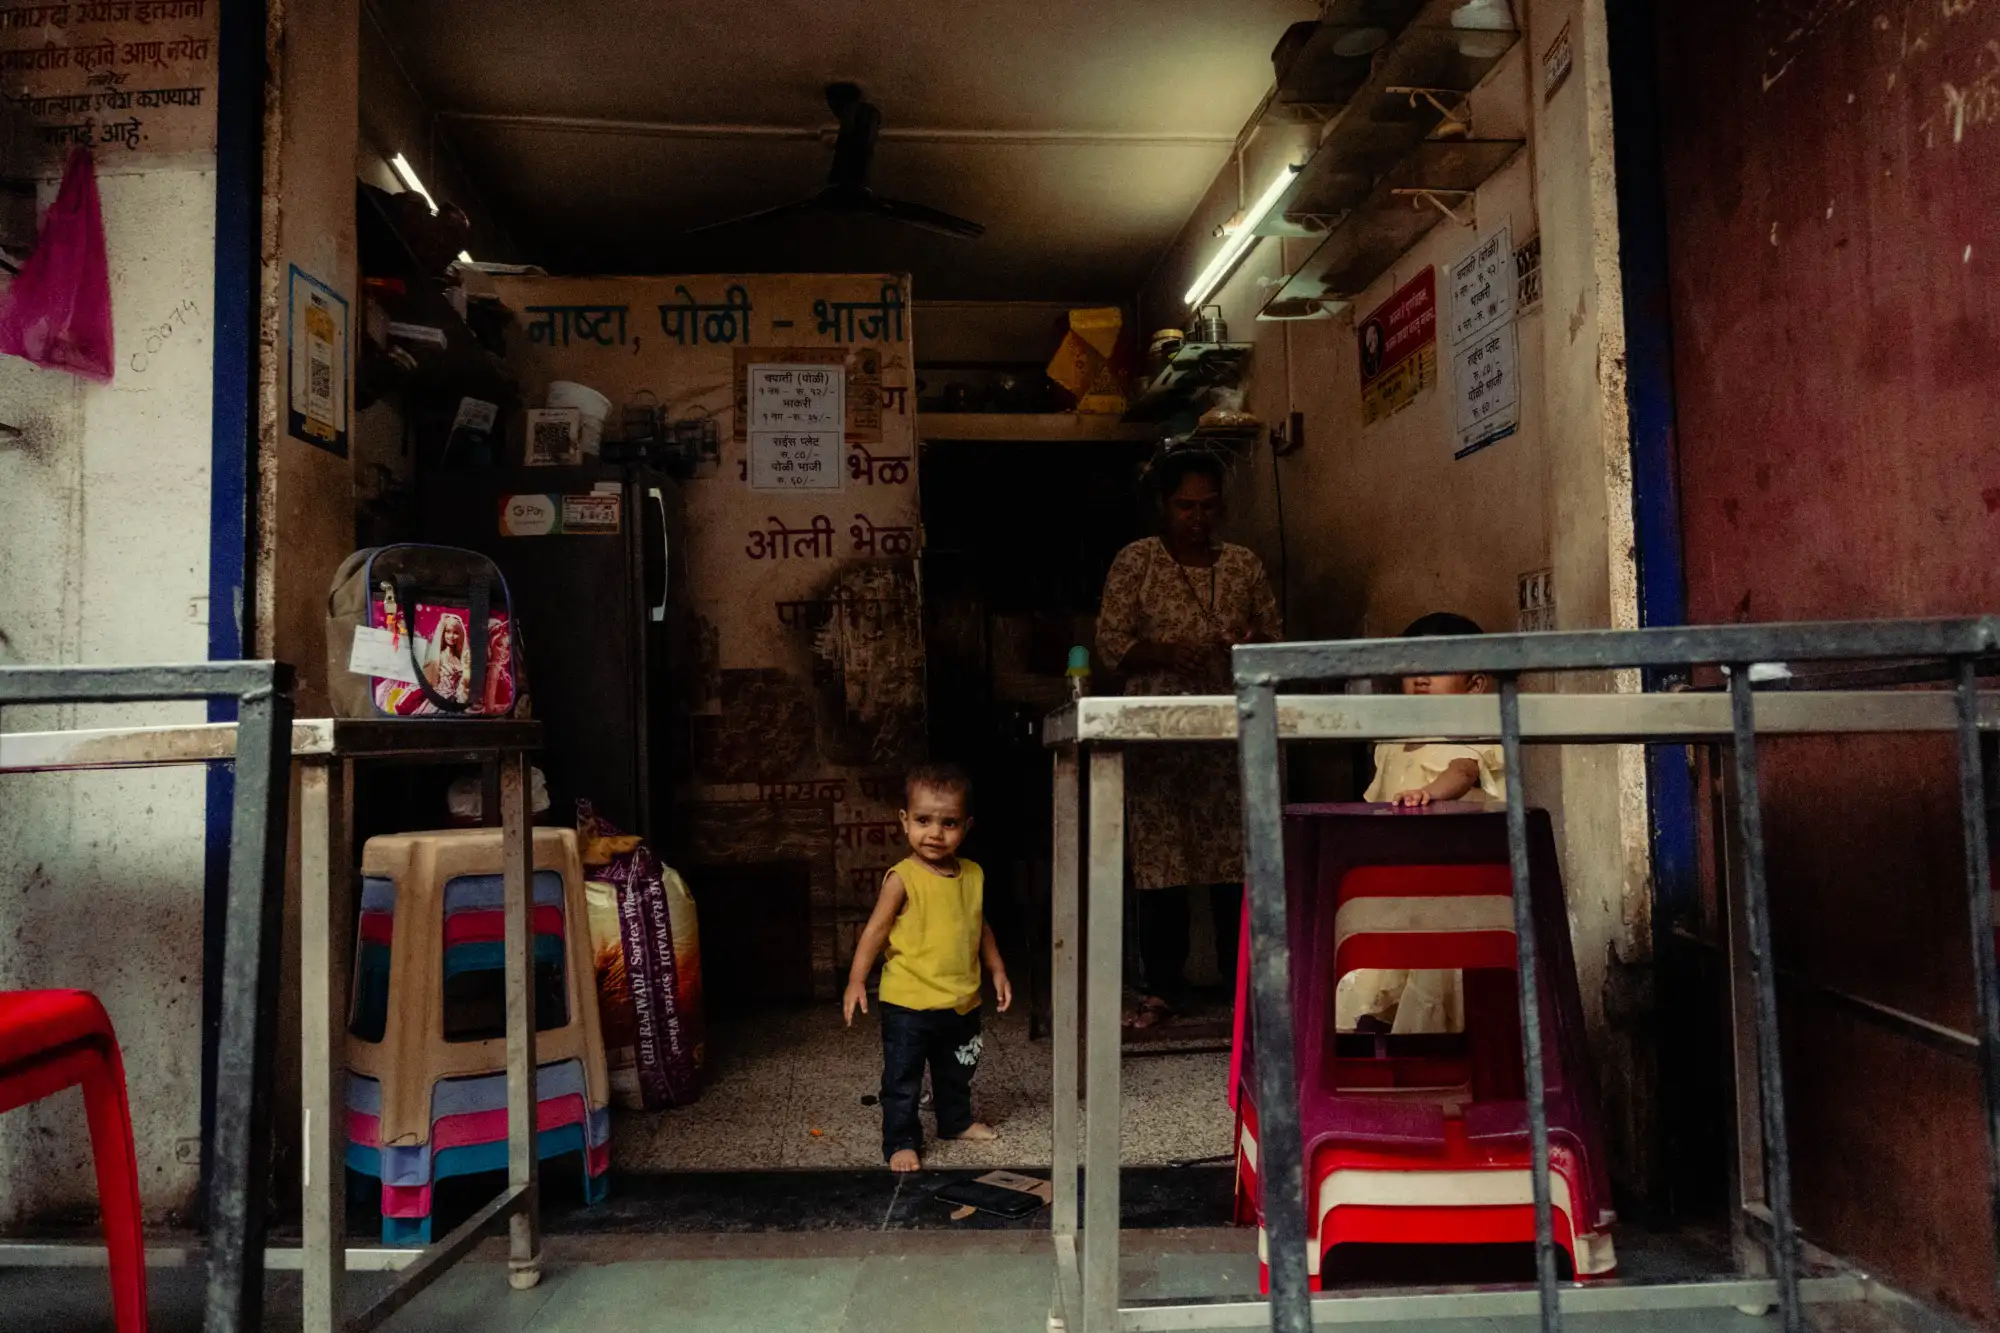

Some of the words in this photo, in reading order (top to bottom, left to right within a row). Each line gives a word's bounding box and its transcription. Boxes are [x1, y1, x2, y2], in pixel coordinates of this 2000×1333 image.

[100, 116, 149, 150] आहे.
[525, 304, 642, 354] नाष्टा,
[658, 284, 752, 345] पोळी
[813, 283, 906, 343] भाजी
[797, 371, 830, 385] (पोळी)
[771, 459, 794, 472] पोळी
[797, 459, 822, 472] भाजी
[847, 443, 912, 486] भेळ
[745, 513, 835, 559] ओली
[850, 513, 913, 557] भेळ
[627, 921, 643, 967] Sortex
[652, 899, 672, 967] RAJWADI
[630, 971, 653, 1037] RAJWADI
